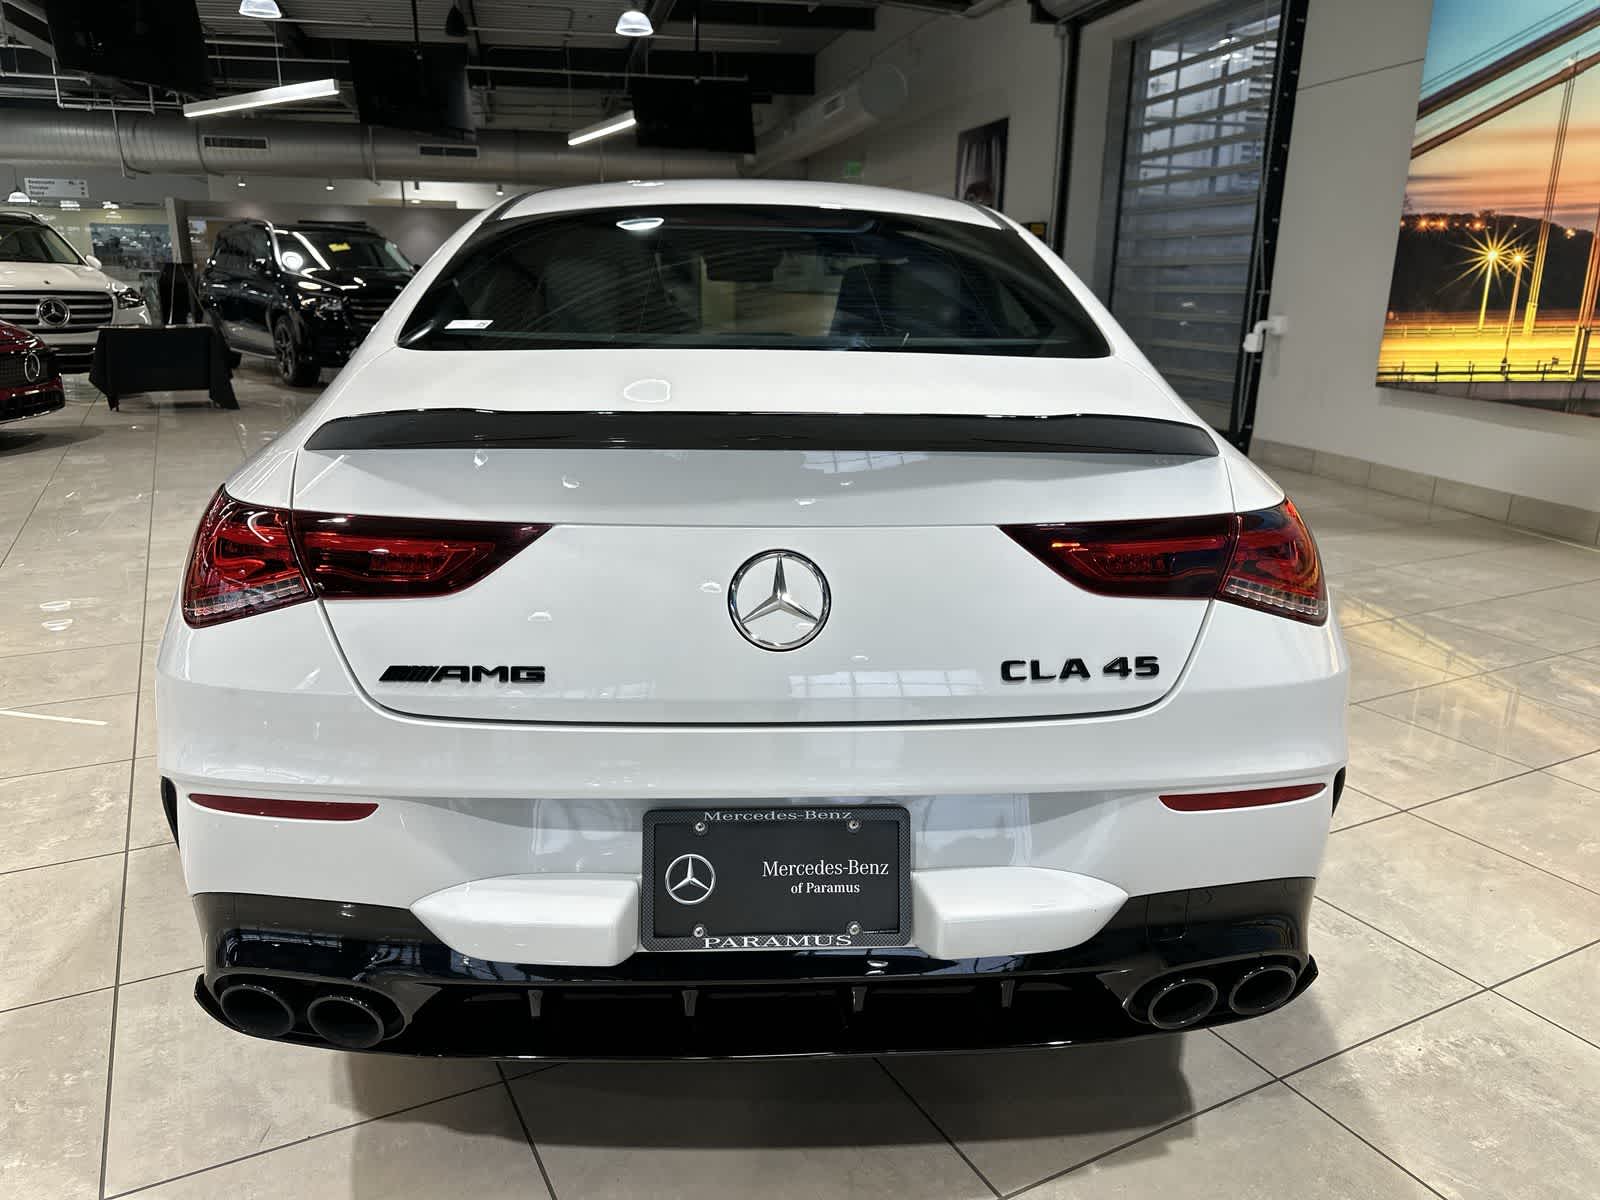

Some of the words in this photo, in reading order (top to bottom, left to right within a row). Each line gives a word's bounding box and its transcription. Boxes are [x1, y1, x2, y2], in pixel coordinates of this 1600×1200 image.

[430, 665, 546, 683] AMG
[1000, 658, 1091, 681] CLA
[1102, 655, 1160, 678] 45
[703, 810, 852, 821] Mercedes-Benz
[762, 860, 889, 876] Mercedes-Benz
[790, 883, 803, 894] of
[806, 883, 860, 894] Paramus
[703, 934, 852, 949] PARAMUS
